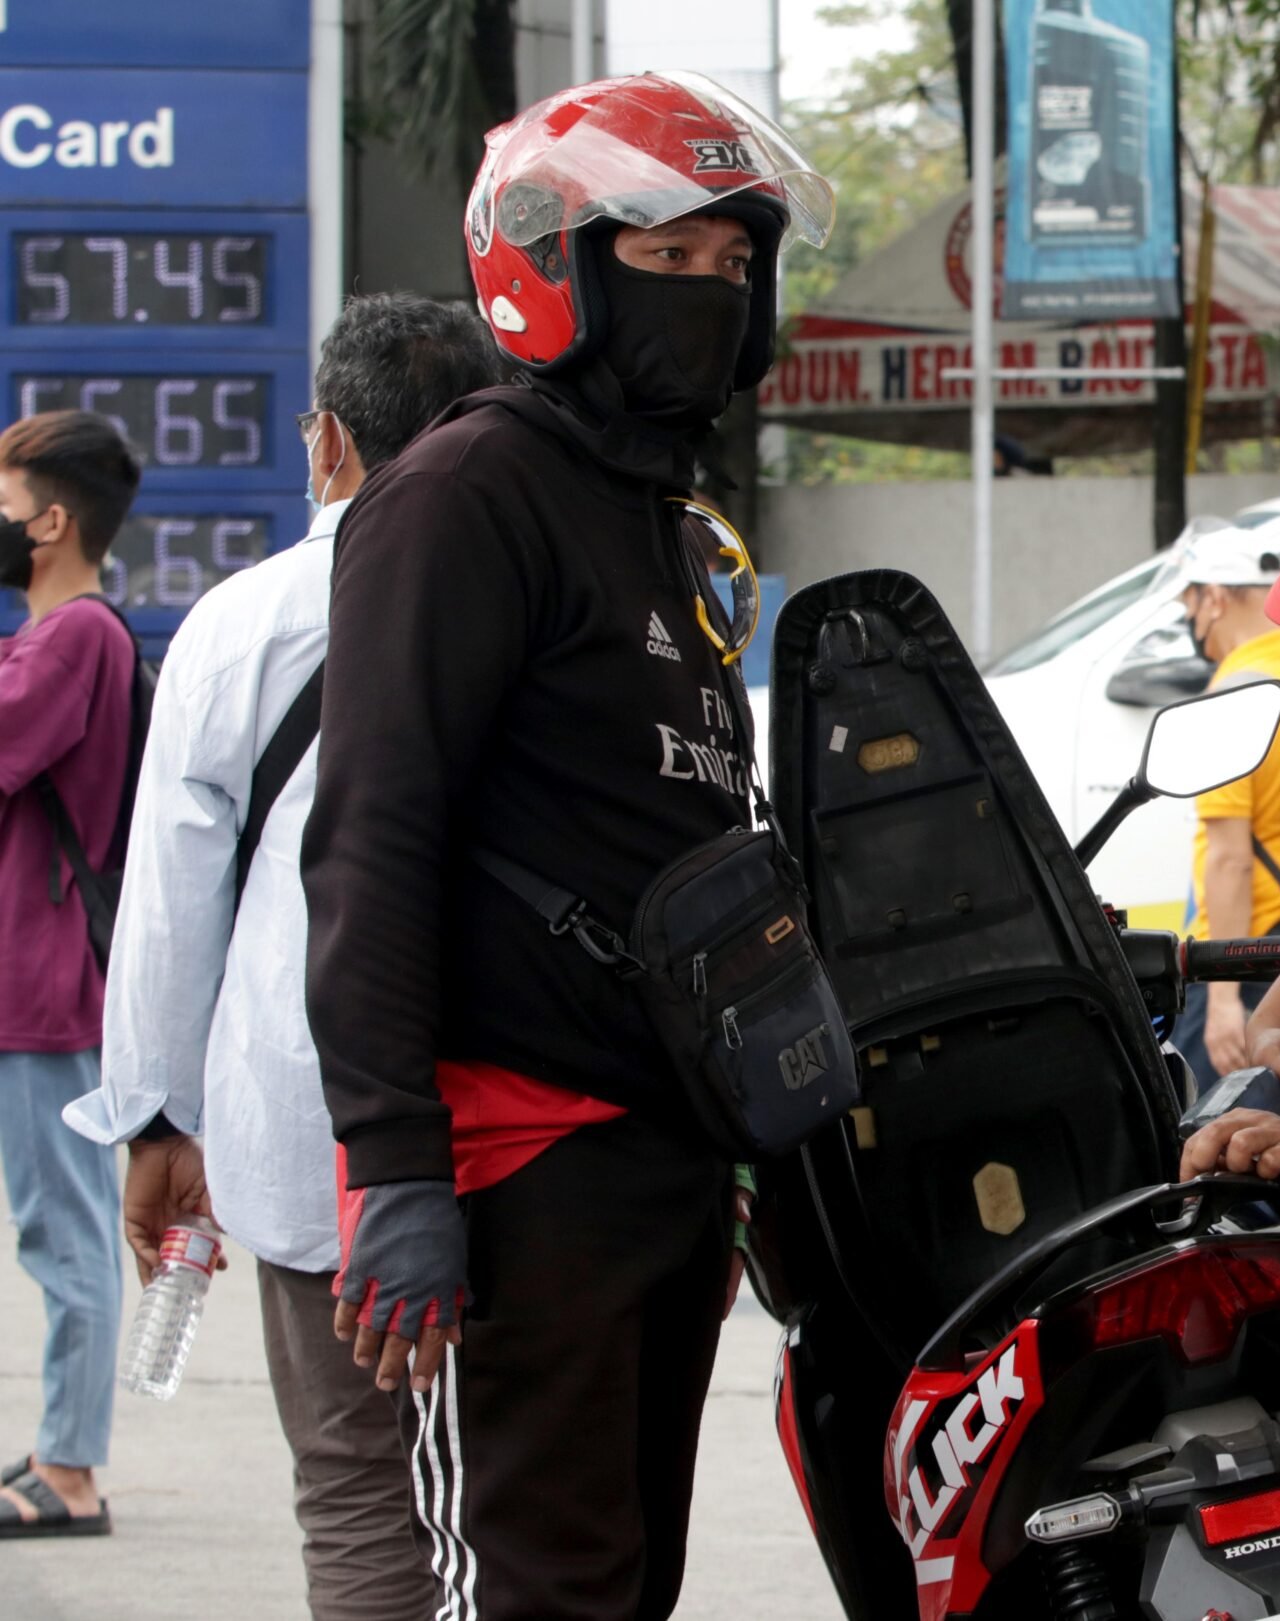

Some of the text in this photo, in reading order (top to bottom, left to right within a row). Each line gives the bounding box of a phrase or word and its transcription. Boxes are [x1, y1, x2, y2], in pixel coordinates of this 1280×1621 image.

[1, 105, 174, 168] Card
[22, 238, 261, 322] 57.45
[1060, 332, 1268, 393] BAUTA
[700, 687, 734, 740] Fly
[778, 1026, 830, 1091] CAT
[899, 1342, 1025, 1560] CLICK
